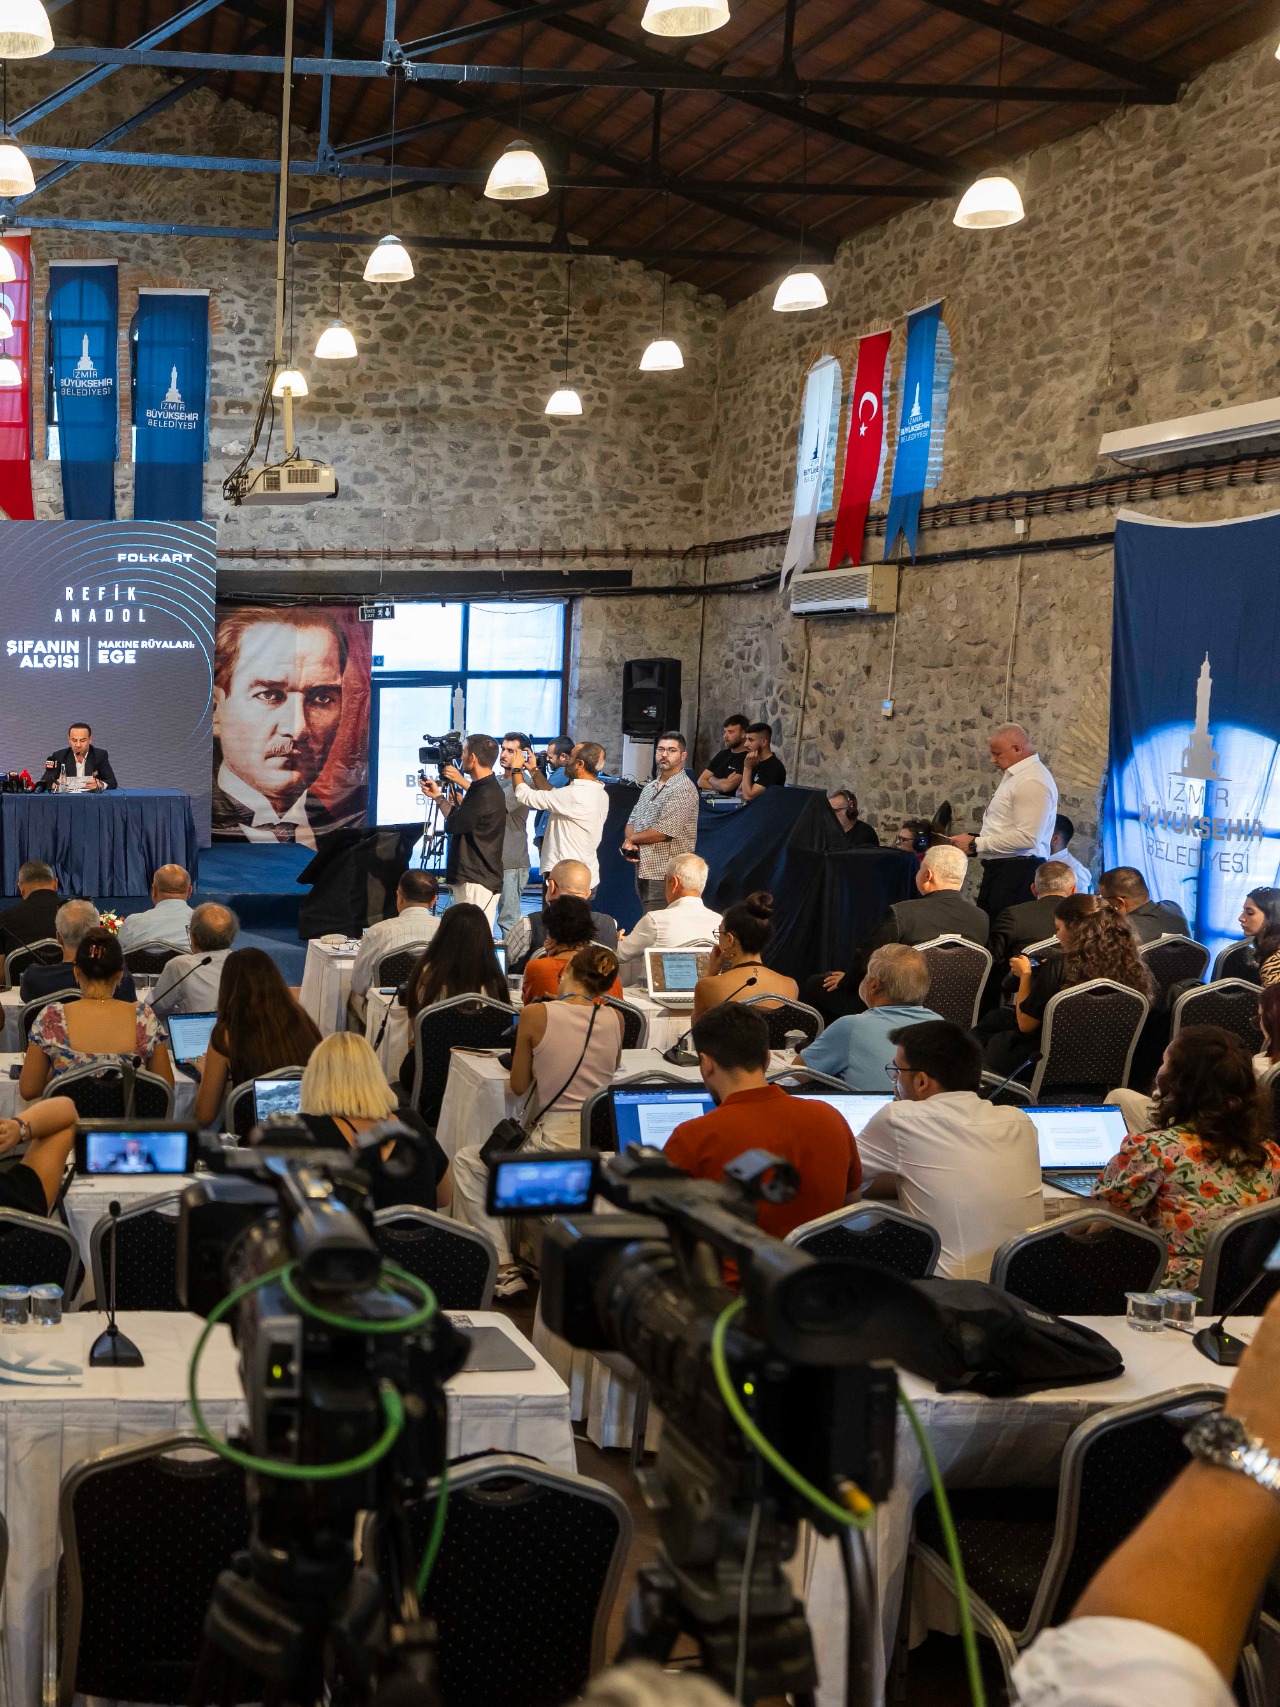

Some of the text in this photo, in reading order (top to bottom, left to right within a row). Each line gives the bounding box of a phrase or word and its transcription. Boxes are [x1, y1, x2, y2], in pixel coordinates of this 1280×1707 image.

[117, 553, 193, 563] FOLKART
[65, 584, 136, 601] REFİK
[54, 608, 146, 623] ANADOL
[98, 650, 136, 664] EGE
[1168, 776, 1229, 808] İZMİR
